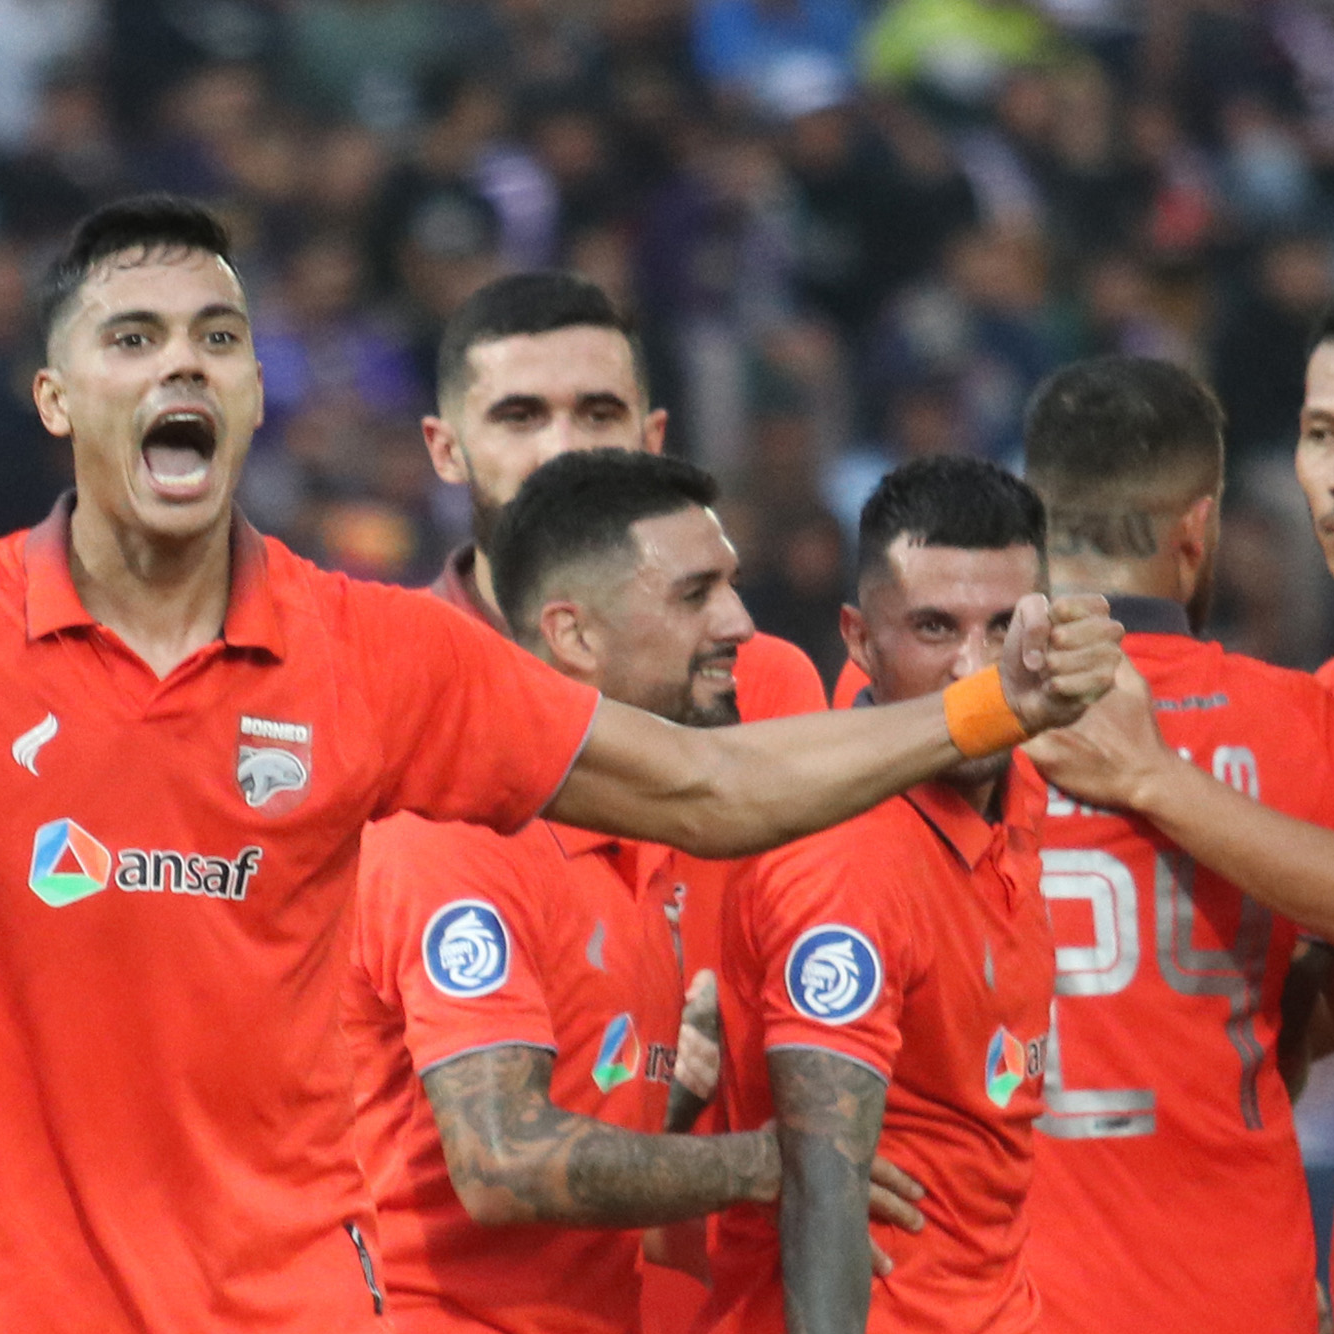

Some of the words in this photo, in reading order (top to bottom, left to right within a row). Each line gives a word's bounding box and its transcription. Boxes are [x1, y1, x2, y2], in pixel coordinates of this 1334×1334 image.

[241, 715, 308, 744] BORNEO
[115, 846, 263, 901] ansaf
[1031, 847, 1273, 1139] 24
